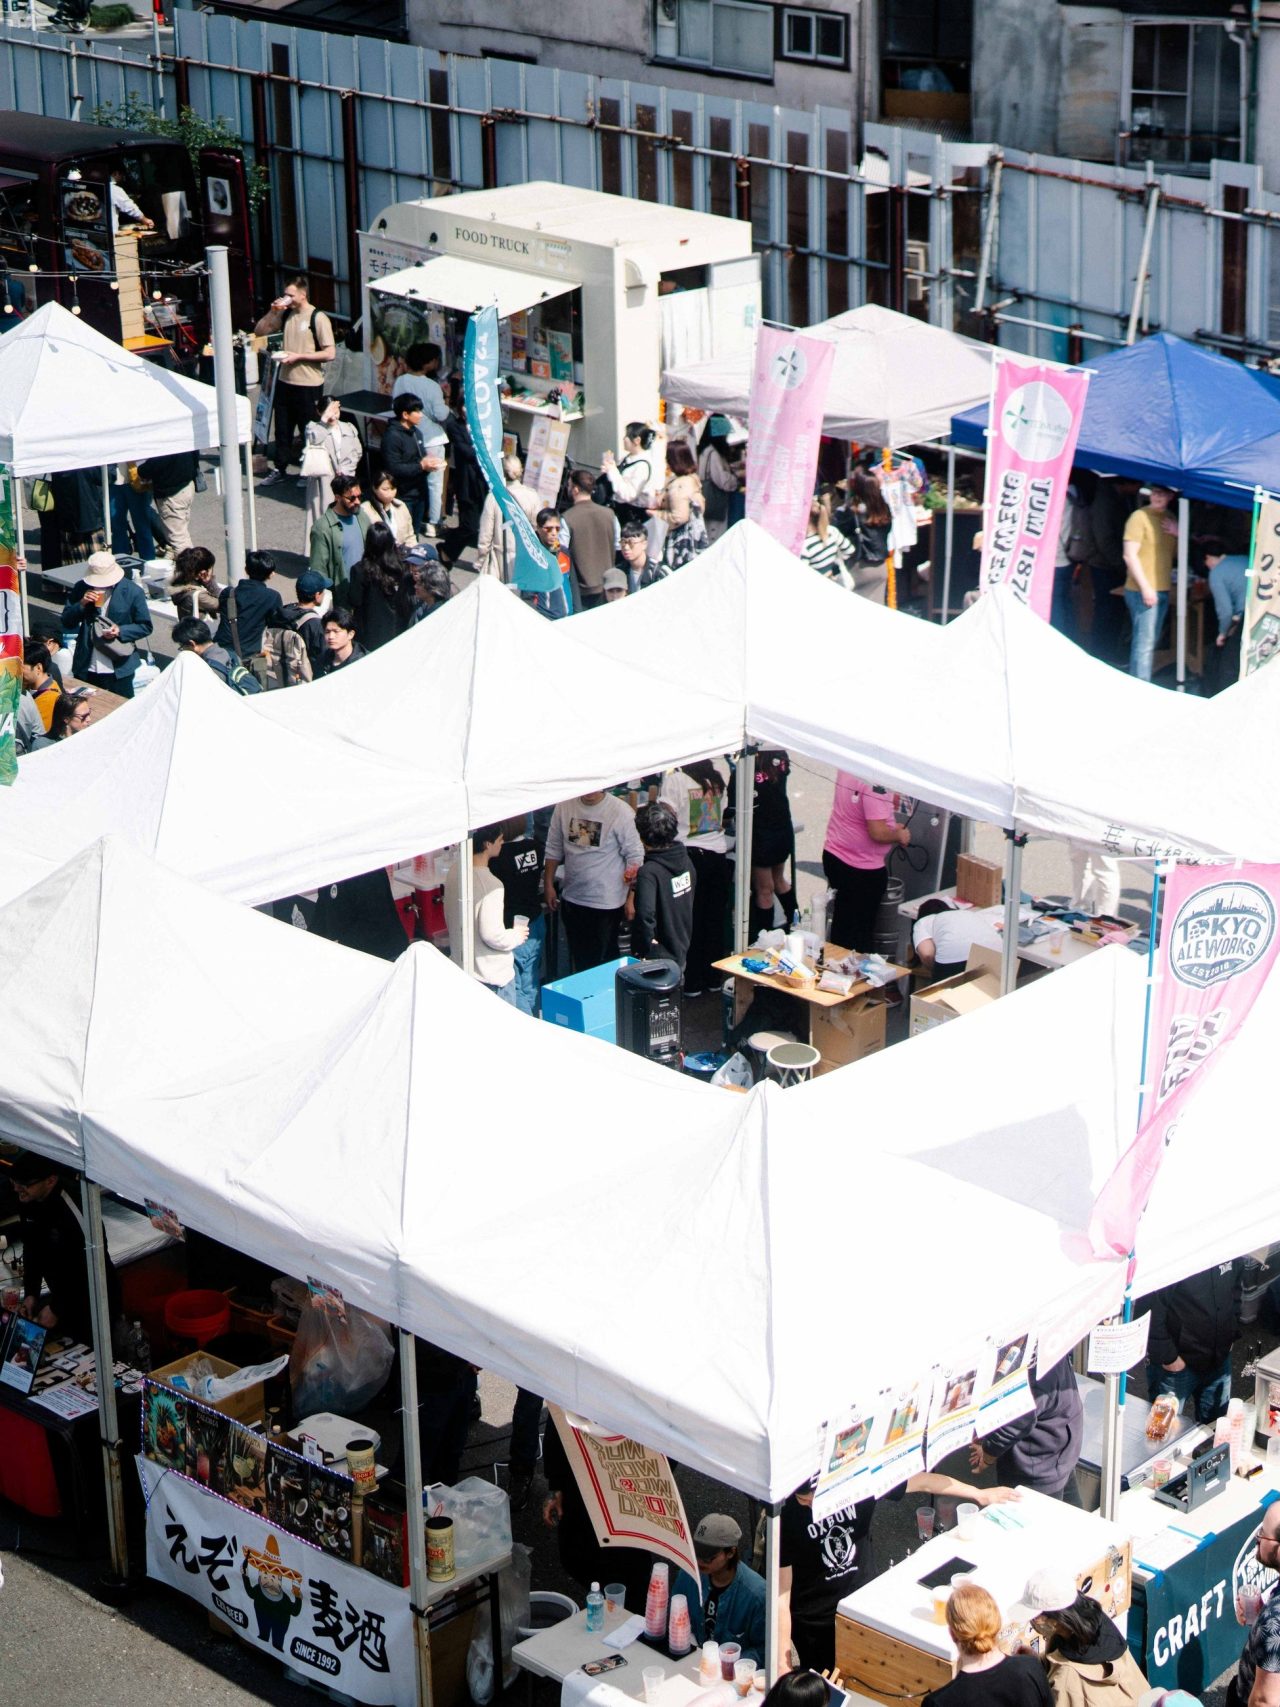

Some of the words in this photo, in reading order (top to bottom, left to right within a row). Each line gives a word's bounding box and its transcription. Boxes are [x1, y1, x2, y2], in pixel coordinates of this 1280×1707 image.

[455, 227, 488, 245] FOOD
[490, 235, 530, 255] TRUCK
[988, 470, 1025, 586] BREWER
[1178, 916, 1263, 944] TOKYO
[1176, 937, 1256, 962] ALEWORKS
[807, 1503, 857, 1539] OXBOW
[164, 1504, 239, 1592] えぞ
[308, 1579, 391, 1674] 麦酒
[1152, 1579, 1227, 1668] CRAFT
[294, 1640, 316, 1662] SINCE
[316, 1652, 337, 1672] 1992
